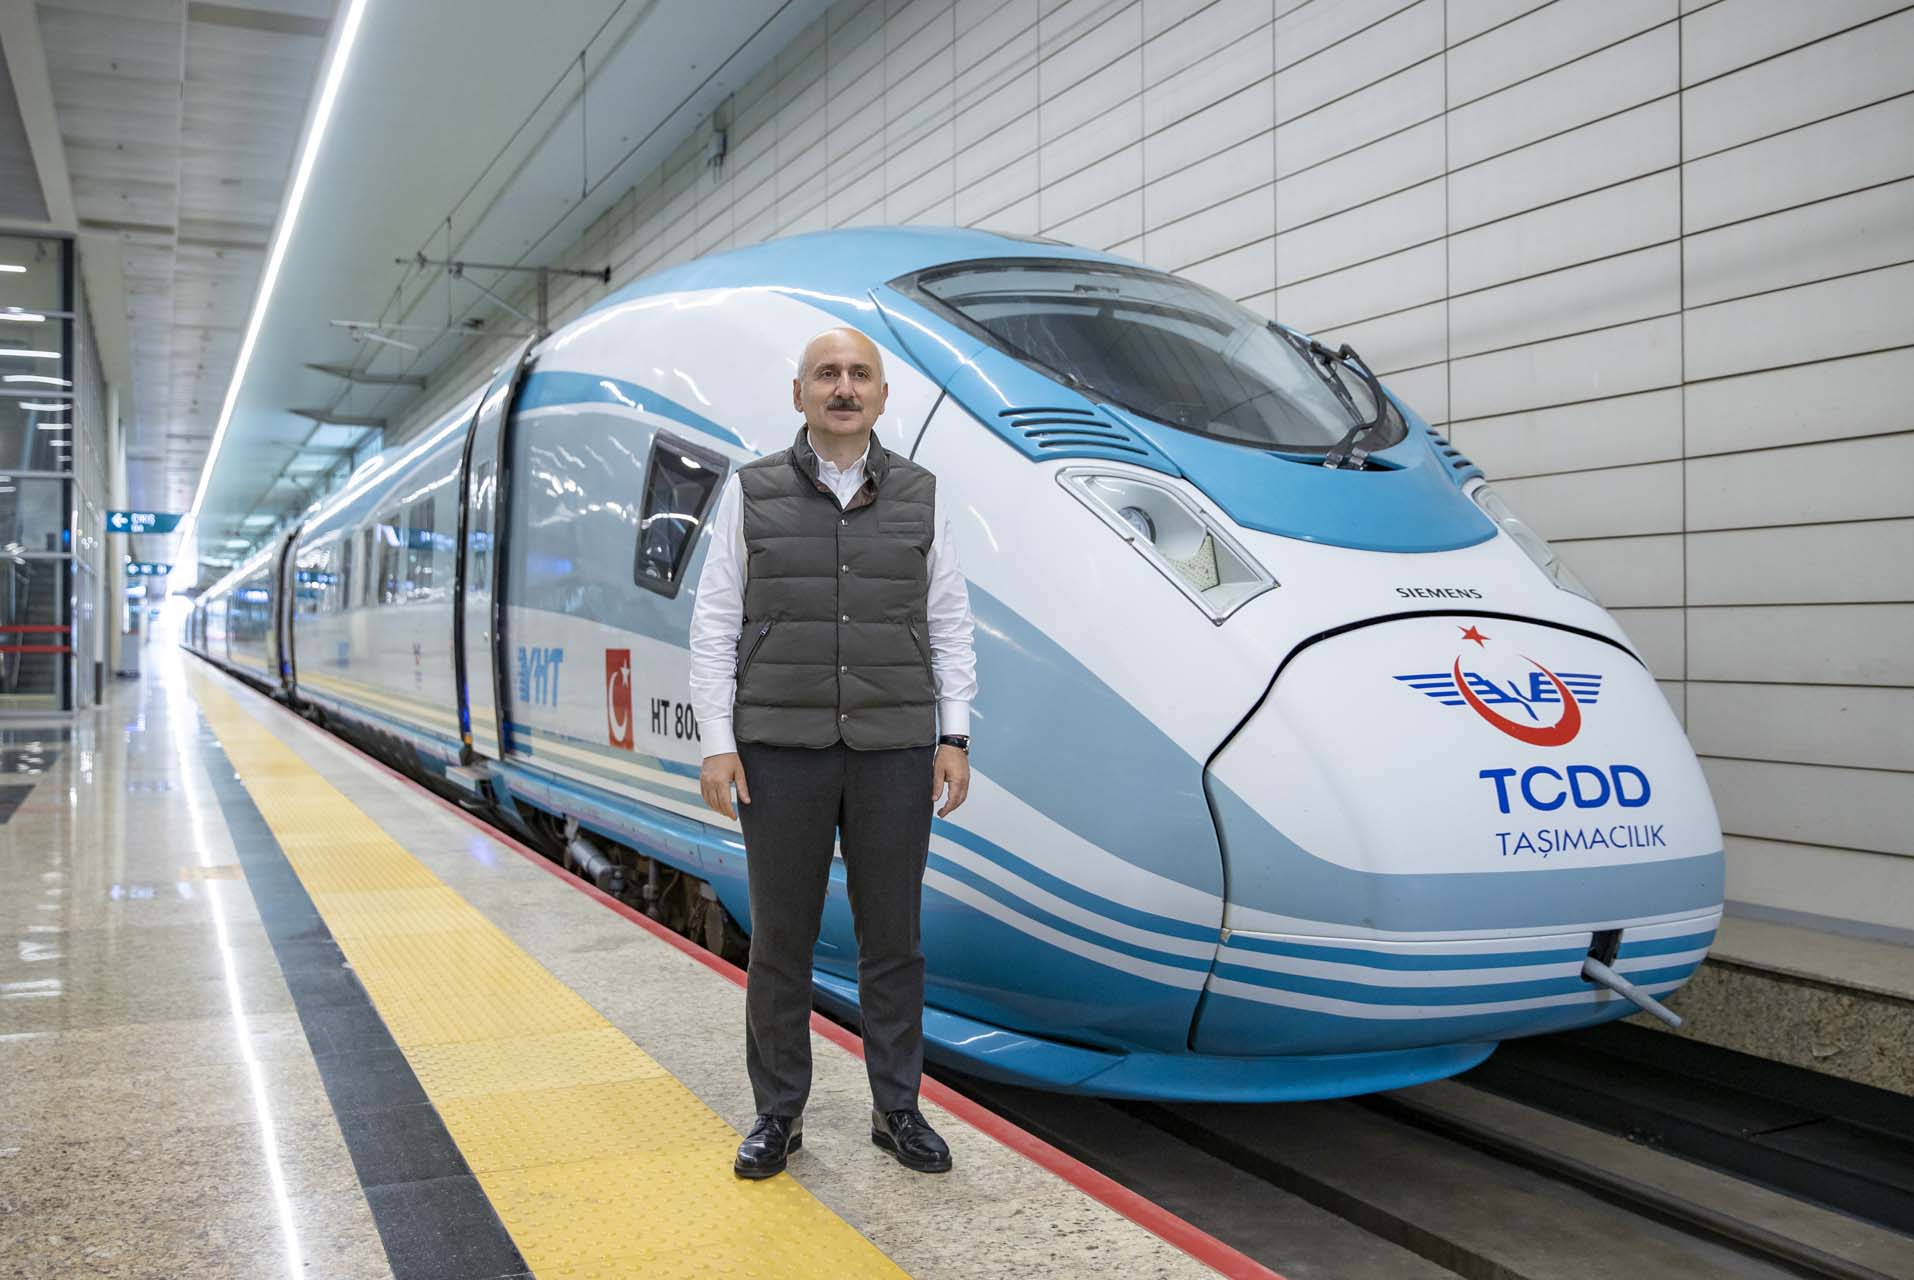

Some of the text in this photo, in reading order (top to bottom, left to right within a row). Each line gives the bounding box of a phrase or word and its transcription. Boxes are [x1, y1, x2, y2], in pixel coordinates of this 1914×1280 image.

[1396, 587, 1483, 600] SIEMENS
[518, 647, 564, 708] YHT
[651, 697, 670, 737] HT
[1480, 765, 1651, 814] TCDD
[1496, 825, 1667, 858] TAŞIMACILIK
